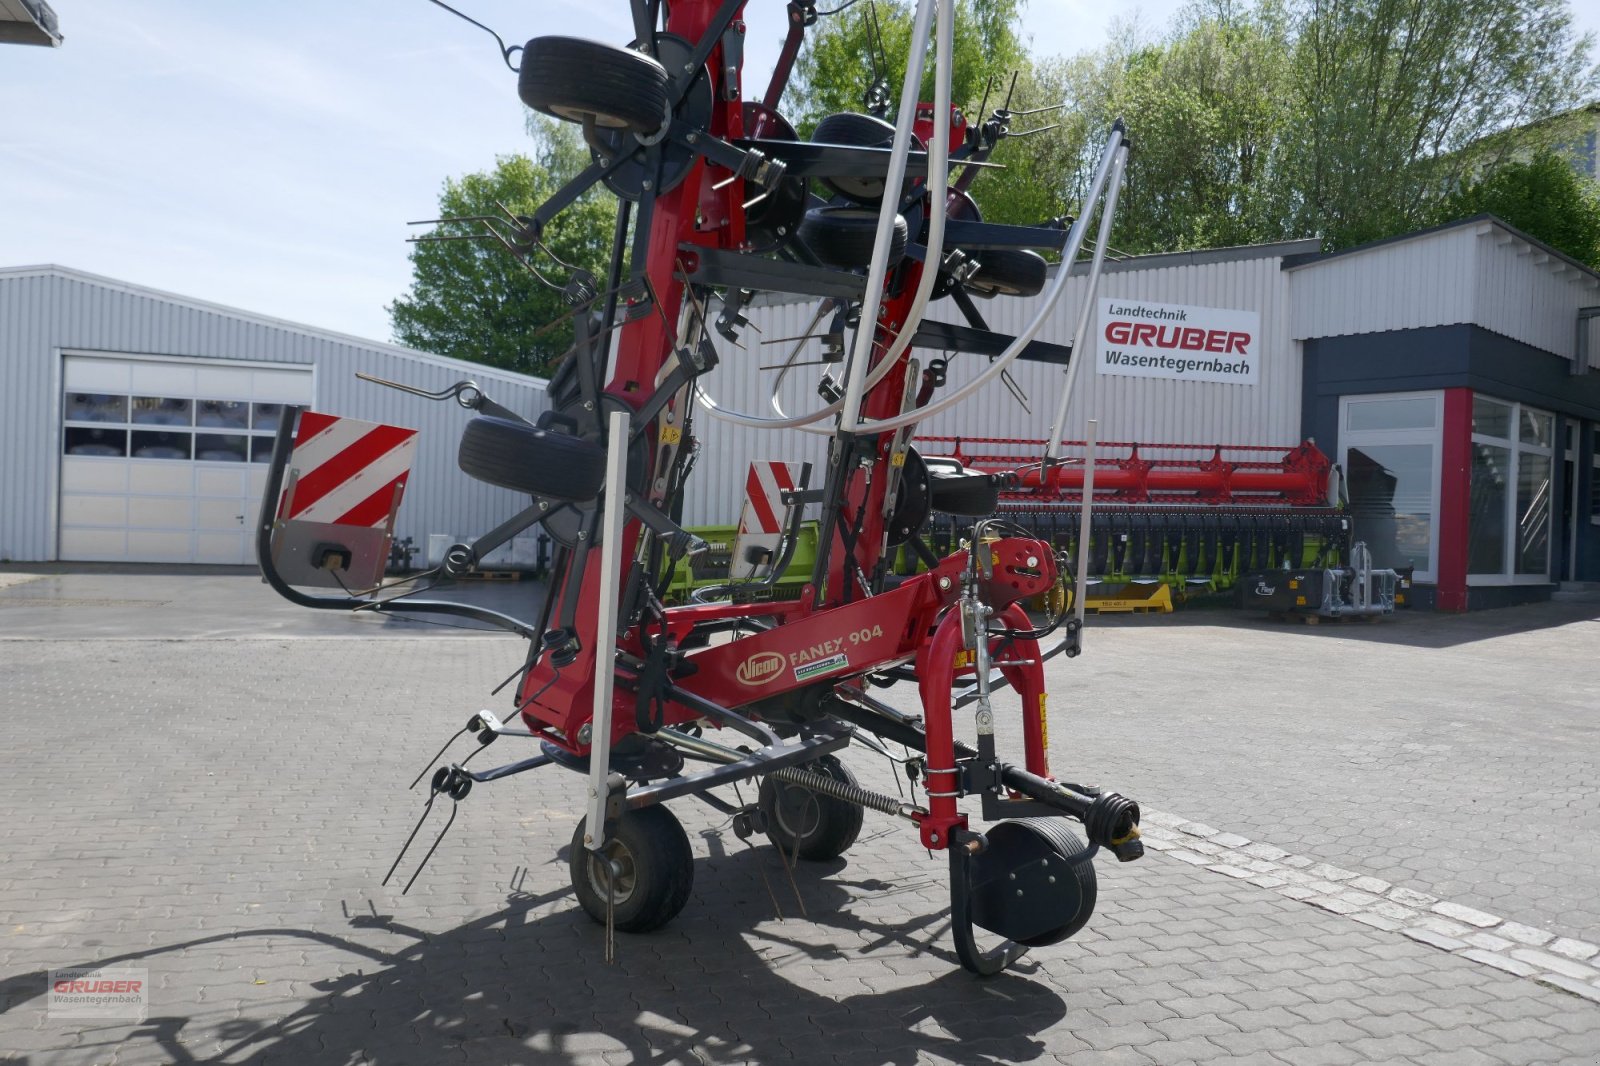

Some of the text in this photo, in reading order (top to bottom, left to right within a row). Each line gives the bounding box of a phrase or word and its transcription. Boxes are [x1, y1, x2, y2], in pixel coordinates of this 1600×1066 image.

[1108, 304, 1187, 321] Landtechnik
[1105, 321, 1251, 355] GRUBER
[1105, 350, 1250, 375] Wasentegernbach
[789, 624, 883, 666] FANEX 904
[740, 655, 779, 680] Vicon
